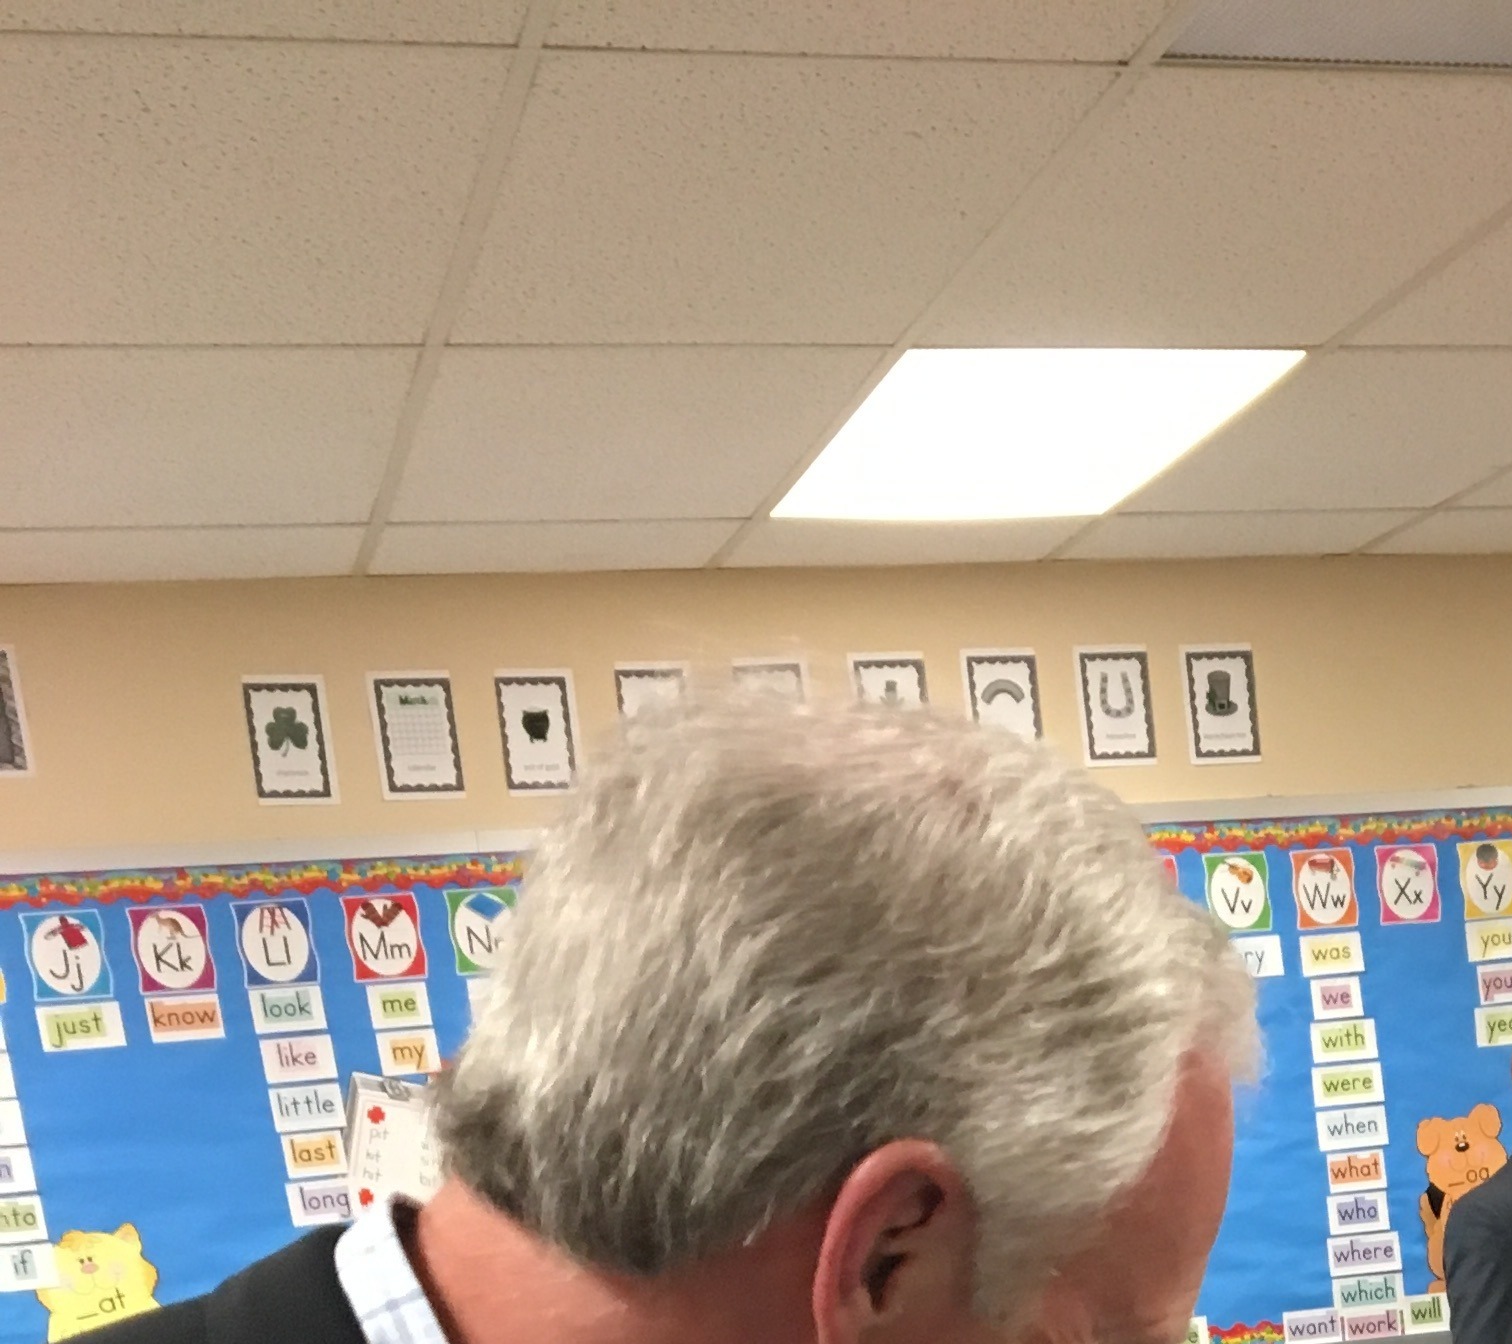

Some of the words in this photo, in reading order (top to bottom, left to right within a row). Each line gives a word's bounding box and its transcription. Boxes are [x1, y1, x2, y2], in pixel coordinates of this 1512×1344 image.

[1221, 887, 1252, 914] Vv
[1303, 882, 1346, 910] Ww
[1393, 878, 1424, 905] Xx
[1476, 873, 1506, 910] Yy
[153, 943, 193, 972] Kk
[359, 931, 411, 960] Mm
[1311, 945, 1351, 962] was
[1480, 931, 1512, 958] you
[49, 949, 84, 992] Jj
[260, 990, 311, 1019] look
[382, 998, 417, 1013] me
[1321, 991, 1351, 1006] we
[150, 1000, 216, 1028] know
[51, 1012, 102, 1048] just
[1321, 1024, 1366, 1048] with
[276, 1043, 317, 1068] like
[391, 1042, 425, 1070] my
[1323, 1075, 1373, 1093] were
[277, 1089, 335, 1117] little
[1327, 1113, 1379, 1136] when
[290, 1138, 336, 1163] last
[1330, 1156, 1380, 1179] what
[299, 1186, 351, 1219] long
[1338, 1198, 1379, 1222] who
[0, 1206, 37, 1229] nto
[13, 1249, 33, 1277] if
[1333, 1239, 1394, 1263] where
[1341, 1277, 1396, 1303] which
[1411, 1297, 1442, 1322] will
[1289, 1315, 1337, 1337] want
[1350, 1310, 1397, 1336] work
